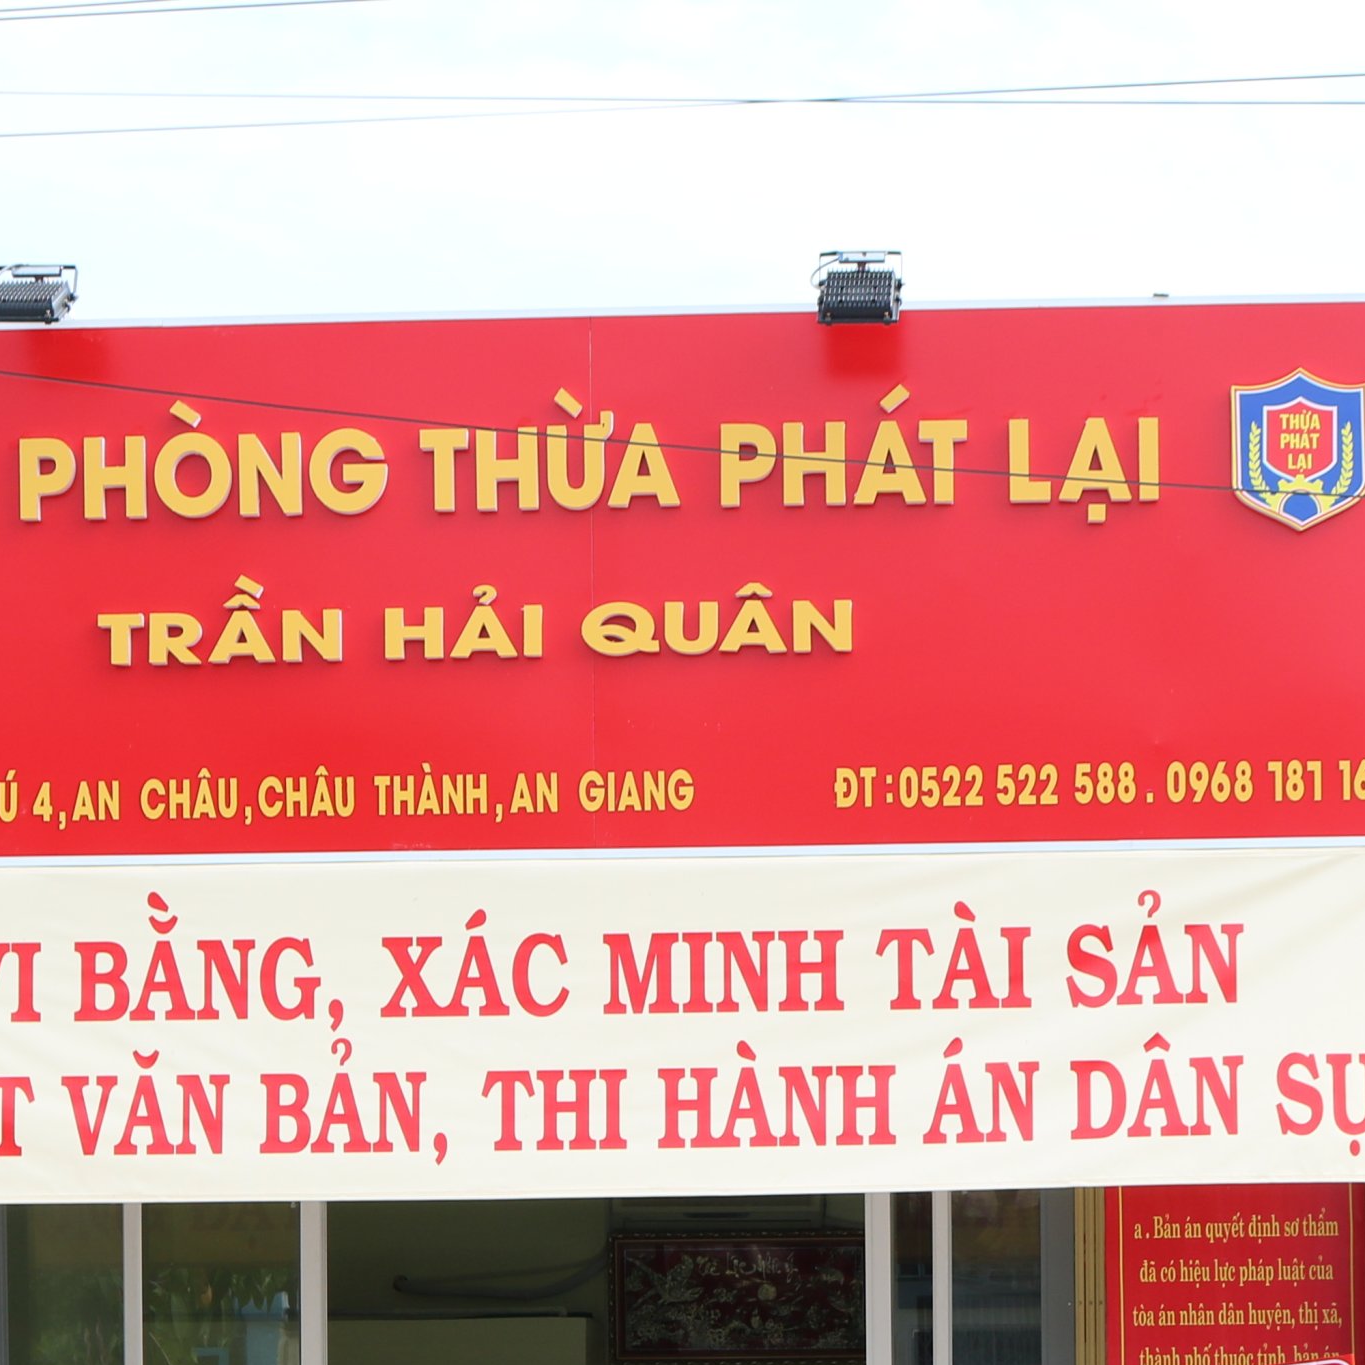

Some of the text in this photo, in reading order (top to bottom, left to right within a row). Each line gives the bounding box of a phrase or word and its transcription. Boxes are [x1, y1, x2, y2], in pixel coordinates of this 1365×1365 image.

[20, 400, 388, 520] PHÒNG
[420, 388, 680, 511] THỪA
[721, 384, 967, 506] PHÁT
[1009, 417, 1159, 522] LẠI
[1280, 430, 1320, 449] PHÁT
[1288, 453, 1312, 473] LẠI
[98, 575, 852, 665] TRẦN HẢI QUÂN
[579, 769, 694, 811] GIANG
[997, 764, 1058, 804] 522
[1167, 761, 1252, 802] 0968
[1268, 760, 1321, 801] 181
[75, 892, 343, 1030] BẰNG,
[381, 909, 569, 1017] XÁC
[603, 930, 844, 1014] MINH
[877, 901, 1032, 1010] TÀI
[1067, 890, 1243, 1008] SẢN
[62, 1051, 230, 1155] VĂN
[260, 1038, 447, 1164] BẢN,
[483, 1069, 627, 1151] THI
[658, 1041, 896, 1148] HÀNH
[923, 1038, 1039, 1144] ÁN
[1071, 1033, 1243, 1139] DÂN
[1153, 1212, 1181, 1239] Bản
[1185, 1217, 1201, 1238] án
[1205, 1211, 1245, 1244] quyết
[1248, 1214, 1281, 1245] định
[1284, 1218, 1300, 1239] sơ
[1302, 1207, 1339, 1238] thẩm
[1139, 1254, 1334, 1289] đã có hiệu lực pháp luật của
[1133, 1301, 1343, 1332] tòa án nhân dân huyện, thị xã,
